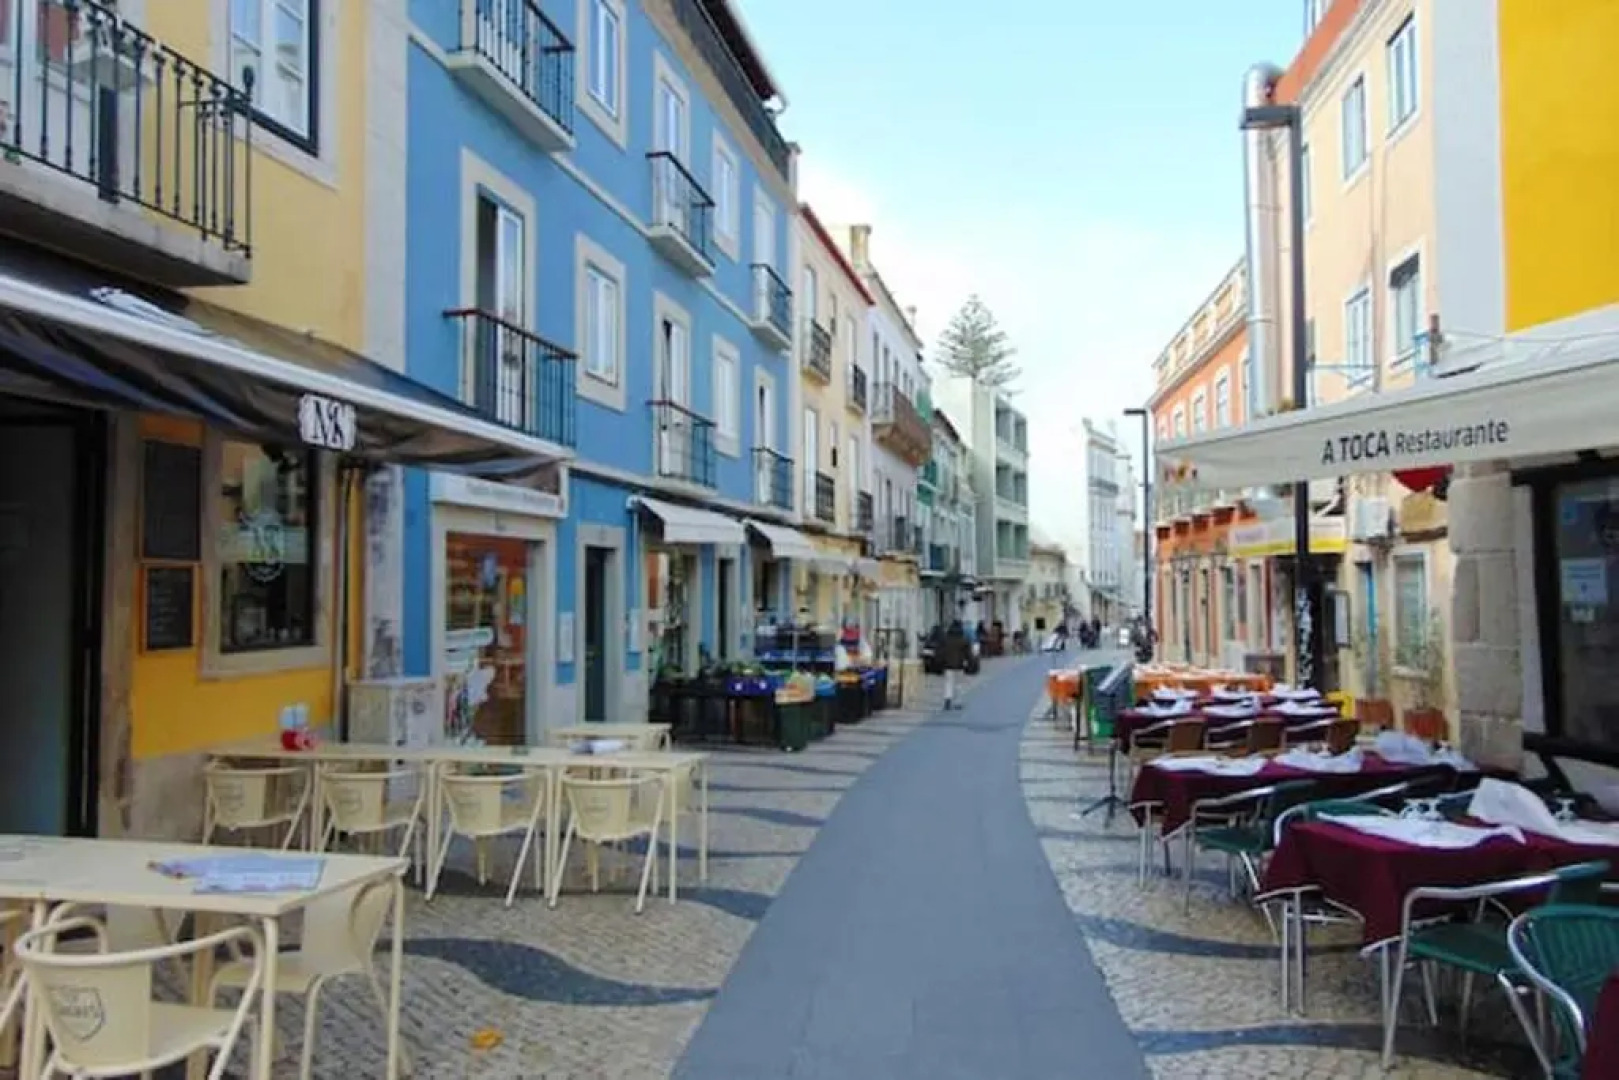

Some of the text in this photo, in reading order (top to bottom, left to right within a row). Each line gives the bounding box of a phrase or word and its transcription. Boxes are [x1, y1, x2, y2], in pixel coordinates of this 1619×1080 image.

[1321, 418, 1509, 465] A TOCA Restaurante
